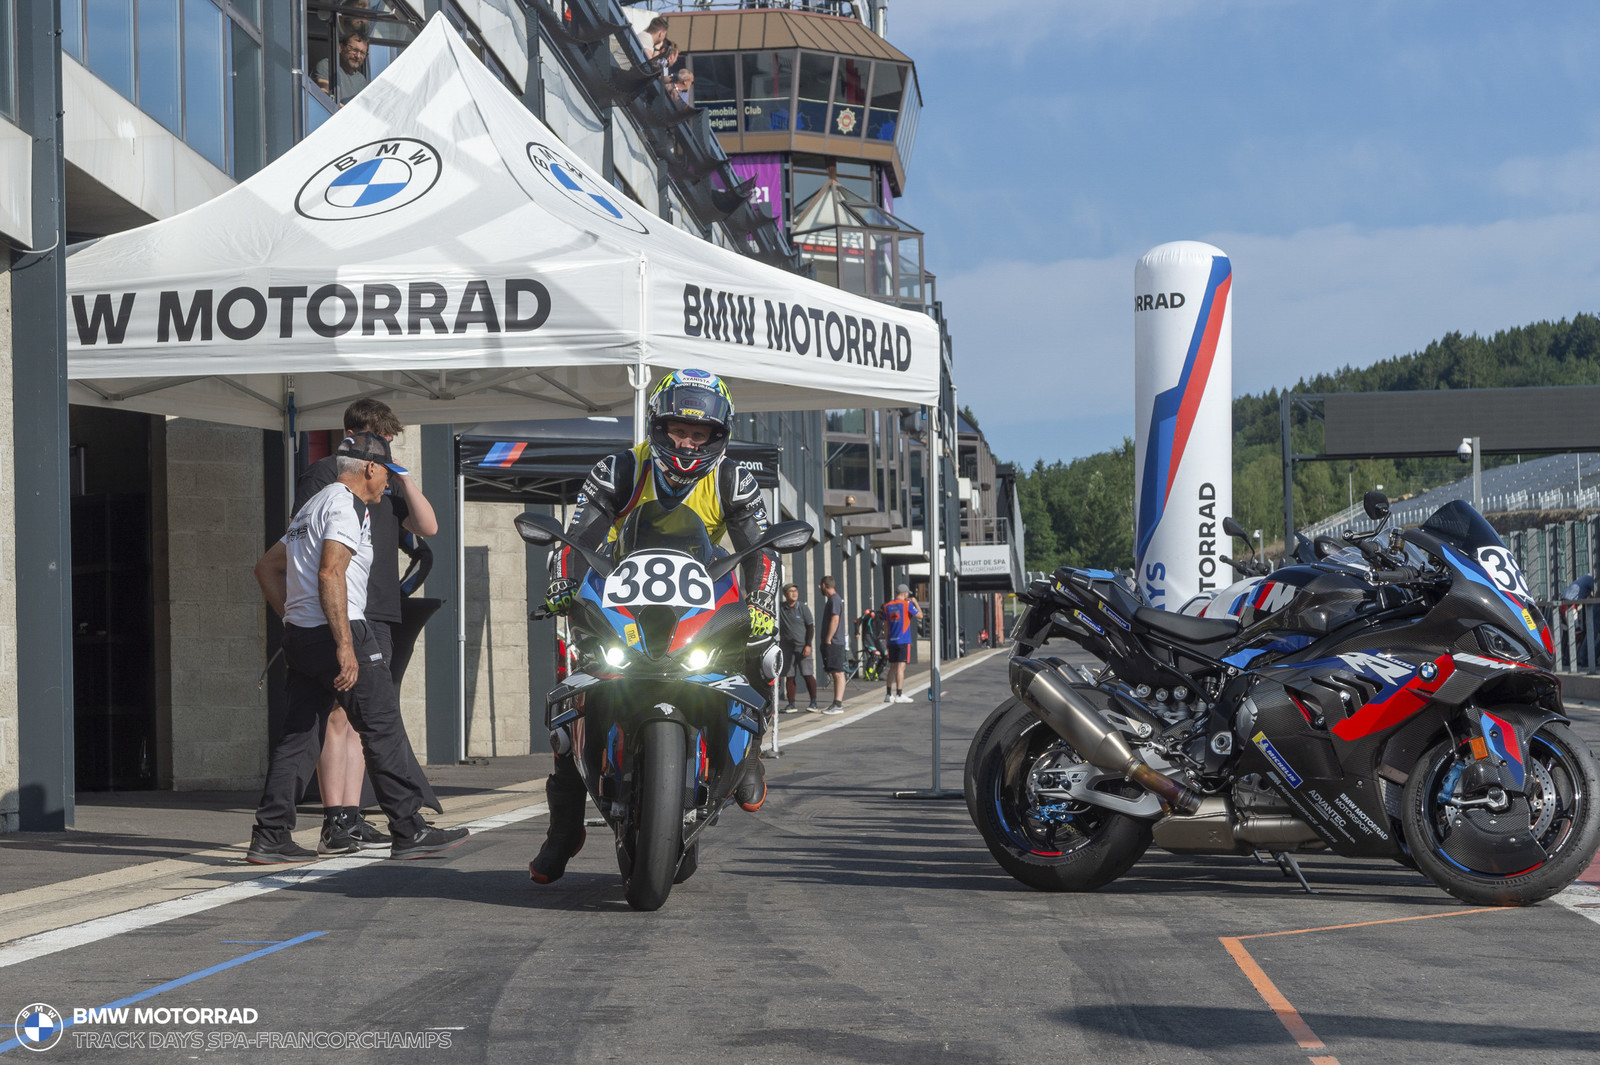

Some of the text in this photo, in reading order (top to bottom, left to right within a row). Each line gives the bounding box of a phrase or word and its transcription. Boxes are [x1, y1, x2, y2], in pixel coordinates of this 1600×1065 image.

[745, 106, 762, 115] Club
[333, 142, 432, 172] BMW
[532, 147, 583, 179] BMW
[156, 278, 552, 343] MOTORRAD
[1135, 292, 1186, 312] RRAD
[683, 283, 912, 372] BMW MOTORRAD
[682, 376, 710, 384] AVANISTA
[607, 556, 712, 606] 386
[1266, 749, 1297, 783] MICHELIN
[1308, 789, 1347, 827] ADVANTEC
[1334, 798, 1374, 836] MOTORSPORT
[1340, 793, 1389, 841] BMW MOTORRAD
